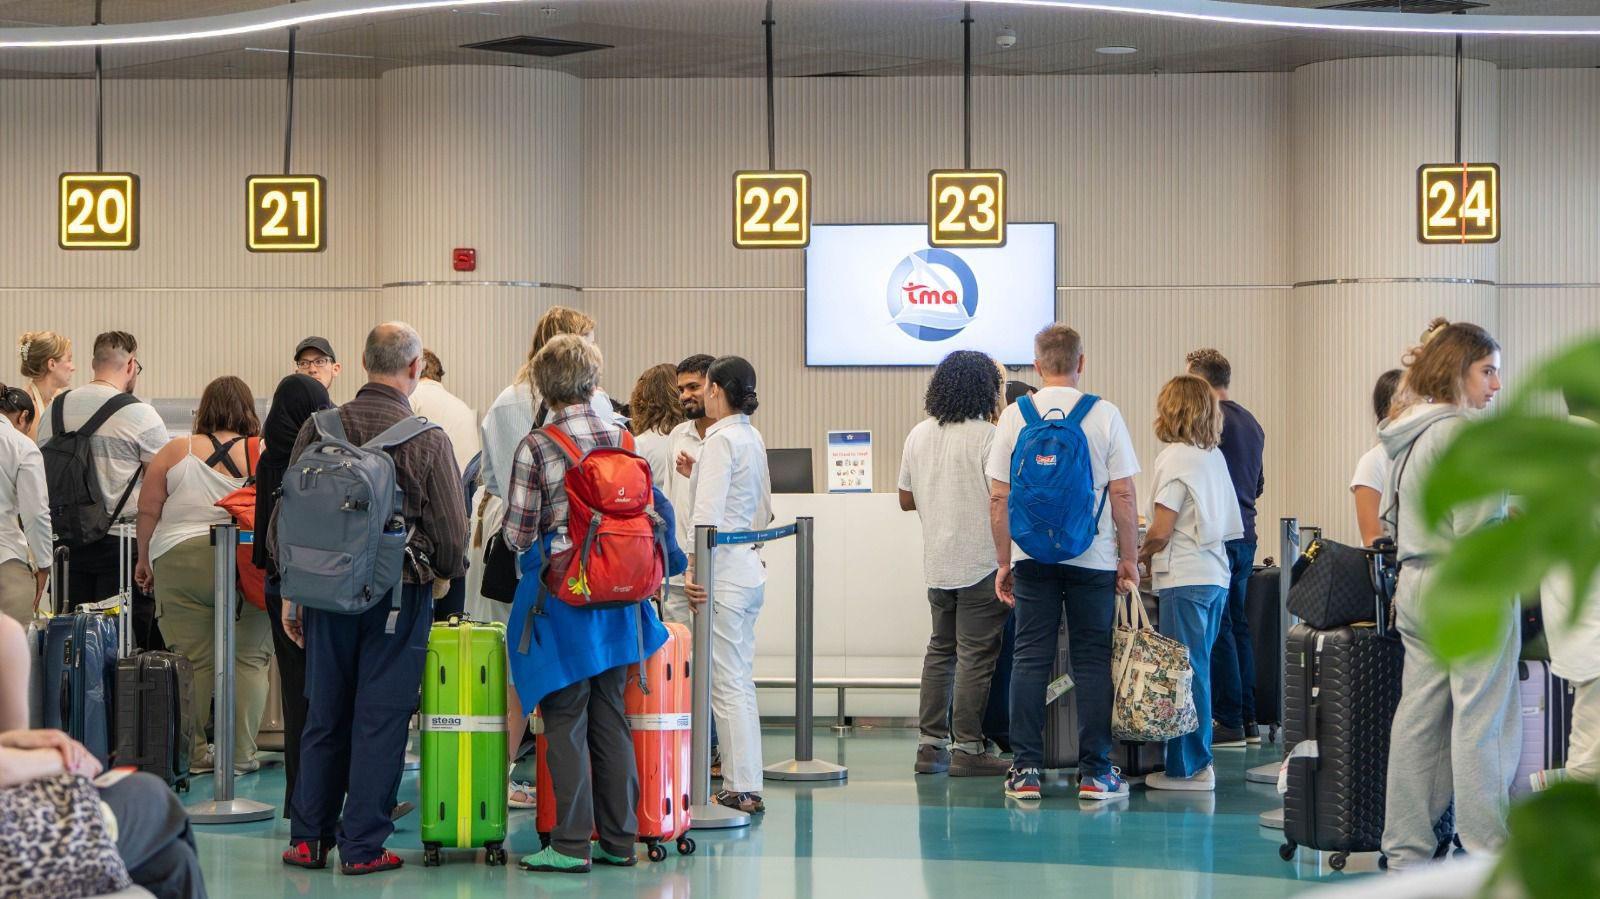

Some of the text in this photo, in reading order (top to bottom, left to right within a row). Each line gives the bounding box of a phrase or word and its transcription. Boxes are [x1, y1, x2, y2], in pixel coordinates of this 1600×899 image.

[67, 188, 126, 234] 20
[261, 190, 308, 237] 21
[743, 186, 800, 233] 22
[938, 184, 996, 232] 23
[1429, 180, 1491, 227] 24
[902, 282, 958, 305] tma
